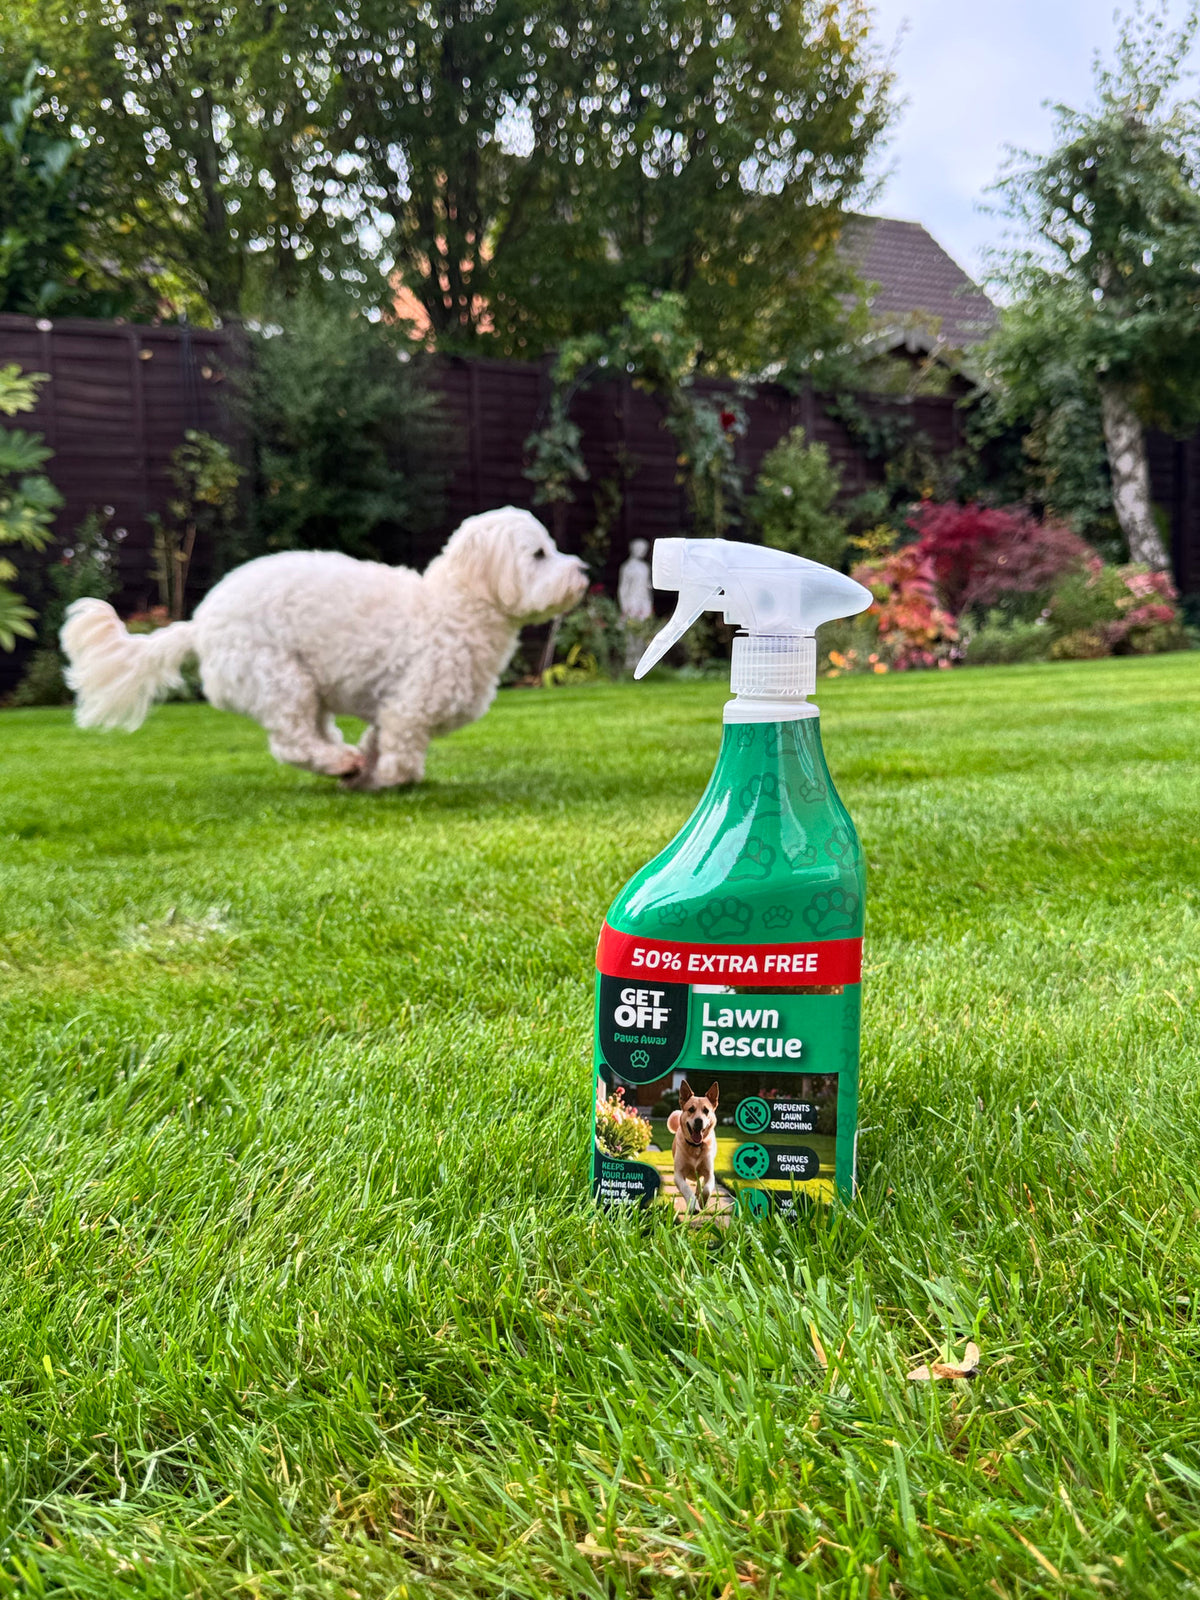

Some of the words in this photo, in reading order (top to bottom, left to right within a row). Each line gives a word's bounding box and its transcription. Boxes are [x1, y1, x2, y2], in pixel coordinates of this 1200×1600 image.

[631, 947, 682, 971] 50%
[687, 953, 759, 973] EXTRA
[763, 953, 819, 973] FREE
[620, 987, 665, 1007] GET
[614, 1004, 669, 1030] OFF
[702, 1002, 779, 1029] Lawn
[613, 1032, 639, 1044] Paws
[640, 1034, 667, 1045] Away
[701, 1030, 803, 1058] Rescue
[773, 1103, 811, 1113] PREVENTS
[781, 1112, 802, 1121] LAWN
[770, 1121, 813, 1131] SCORCHING
[777, 1154, 809, 1164] REVIVES
[602, 1161, 625, 1170] KEEPS
[780, 1163, 806, 1173] GRASS
[602, 1170, 620, 1179] YOUR
[621, 1172, 644, 1180] LAWN
[627, 1180, 645, 1189] lush,
